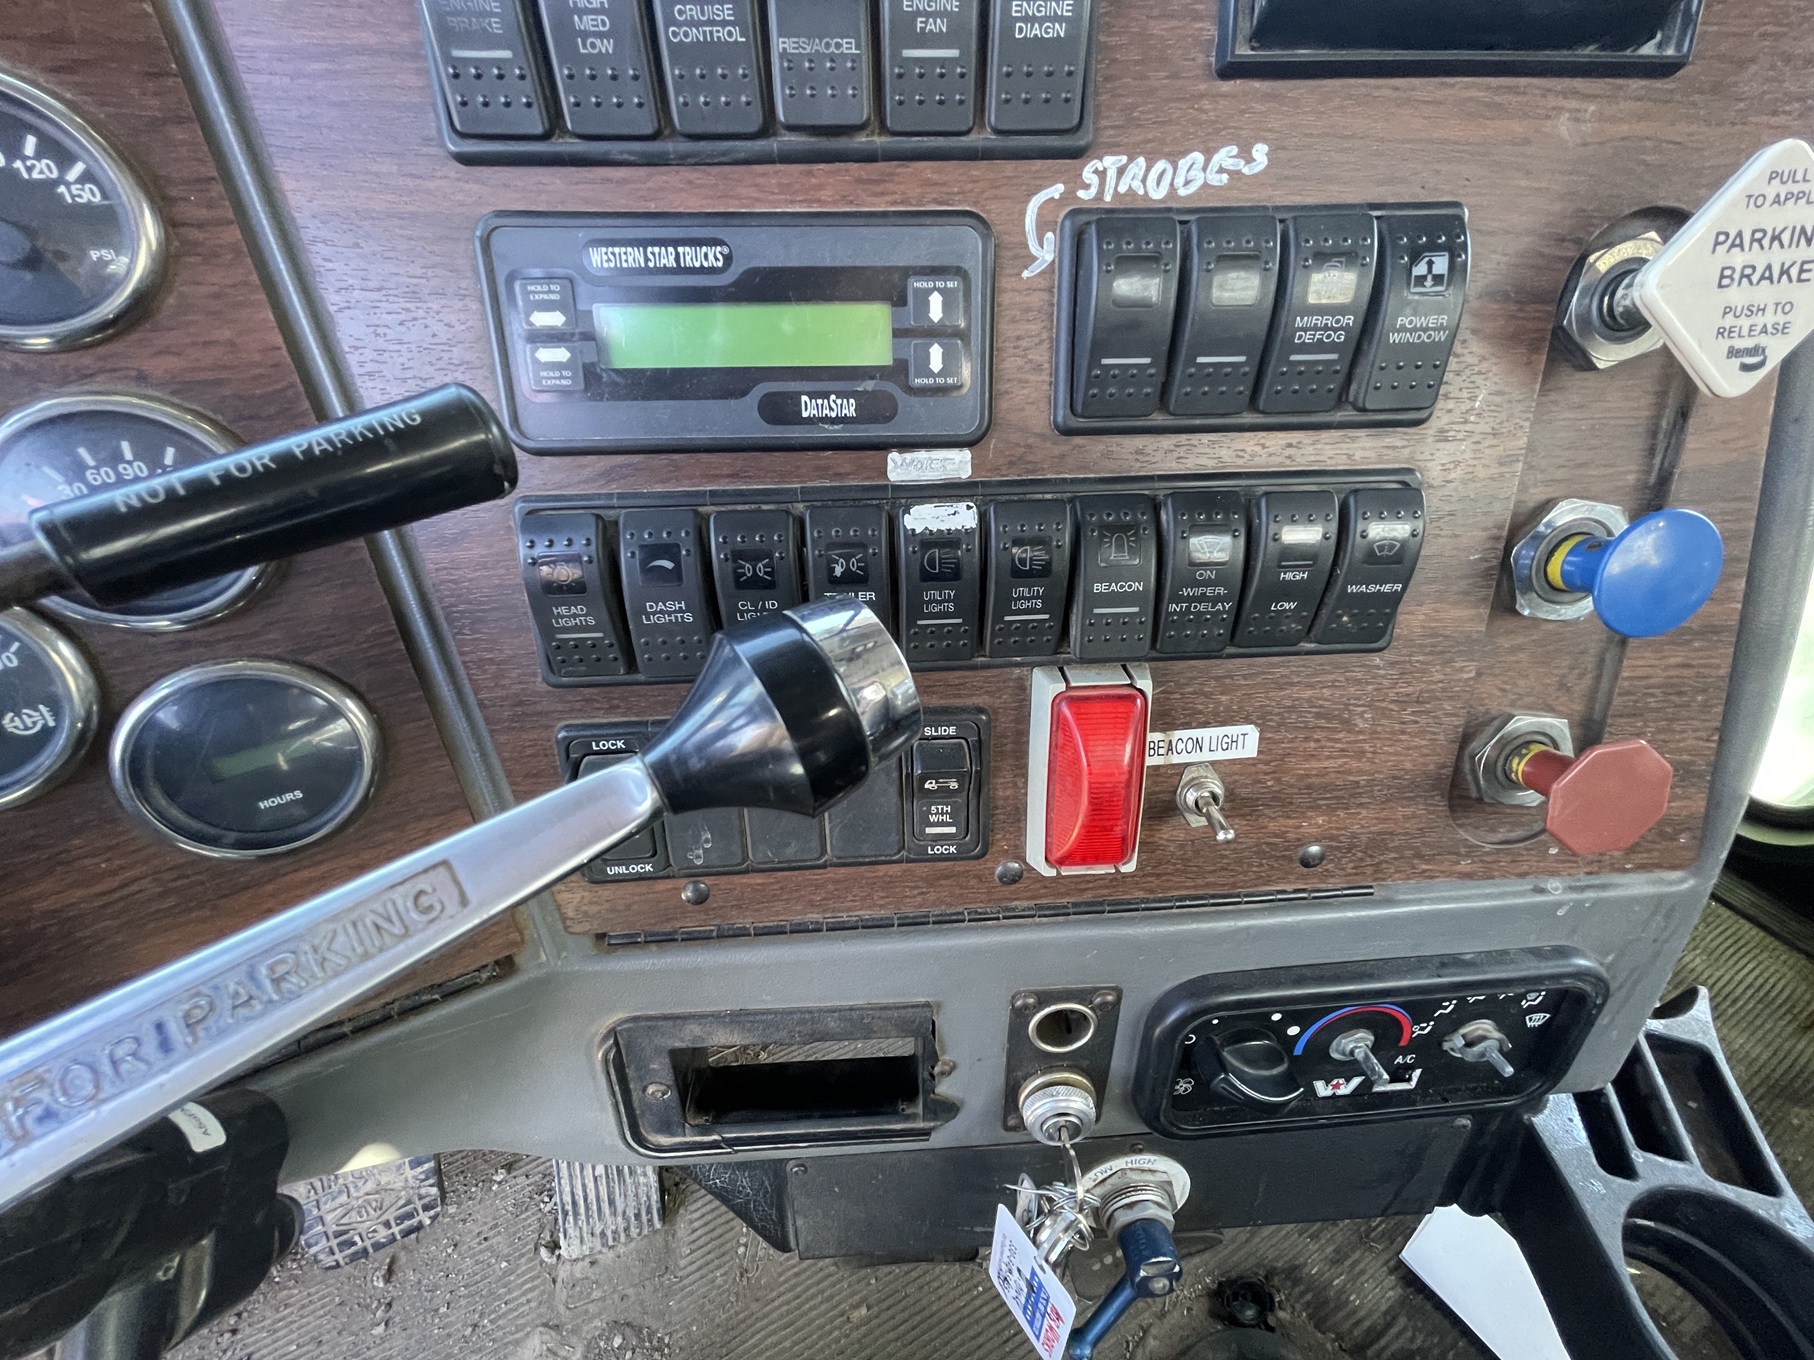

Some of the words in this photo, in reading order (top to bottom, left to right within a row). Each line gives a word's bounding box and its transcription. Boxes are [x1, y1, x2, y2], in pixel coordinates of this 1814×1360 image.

[903, 0, 959, 11] ENGINE
[1011, 1, 1073, 17] ENGINE
[674, 5, 735, 21] CRUISE
[574, 14, 610, 31] MED
[916, 18, 947, 33] FAN
[668, 26, 746, 43] CONTROL
[1015, 23, 1065, 38] DIAGN
[577, 38, 614, 54] LOW
[778, 38, 861, 54] RES/ACCEL
[12, 158, 59, 179] 120
[1076, 143, 1270, 202] STROBES
[1767, 168, 1812, 186] PULL
[57, 183, 101, 203] 150
[1745, 193, 1766, 209] TO
[1770, 190, 1814, 208] APPL
[1711, 225, 1814, 255] PARKIN
[90, 249, 117, 261] PSI
[589, 246, 645, 268] WESTERN
[646, 246, 677, 268] STAR
[1717, 259, 1814, 290] BRAKE
[1722, 303, 1767, 320] PUSH
[1773, 301, 1794, 316] TO
[1295, 316, 1354, 329] MIRROR
[1397, 315, 1448, 329] POWER
[1294, 330, 1346, 344] DEFOG
[1389, 330, 1449, 344] WINDOW
[1715, 322, 1791, 340] RELEASE
[1726, 343, 1768, 360] Bendix
[207, 453, 277, 486] FOR
[292, 407, 423, 460] PARKING
[86, 467, 116, 485] 60
[118, 461, 148, 480] 90
[1195, 570, 1216, 580] ON
[1279, 569, 1308, 581] HIGH
[1012, 586, 1045, 598] UTILITY
[1093, 581, 1144, 593] BEACON
[1346, 583, 1402, 594] WASHER
[923, 590, 955, 601] UTILITY
[552, 606, 587, 616] HEAD
[645, 601, 686, 612] DASH
[738, 601, 756, 610] CL
[765, 600, 778, 609] ID
[923, 602, 955, 613] LIGHTS
[1011, 598, 1043, 610] LIGHTS
[1168, 602, 1188, 612] INT
[1190, 601, 1233, 613] DELAY
[1270, 601, 1298, 611] LOW
[552, 616, 595, 627] LIGHTS
[642, 612, 693, 624] LIGHTS
[923, 725, 957, 736] SLIDE
[592, 739, 626, 751] LOCK
[1147, 737, 1203, 757] BEACON
[1208, 733, 1249, 753] LIGHT
[258, 790, 304, 810] HOURS
[930, 804, 951, 814] 5TH
[929, 813, 953, 823] WHL
[927, 844, 957, 855] LOCK
[606, 862, 654, 875] UNLOCK
[181, 883, 448, 1048] PARKING
[1394, 1054, 1416, 1065] A/C
[1125, 1158, 1157, 1167] HIGH
